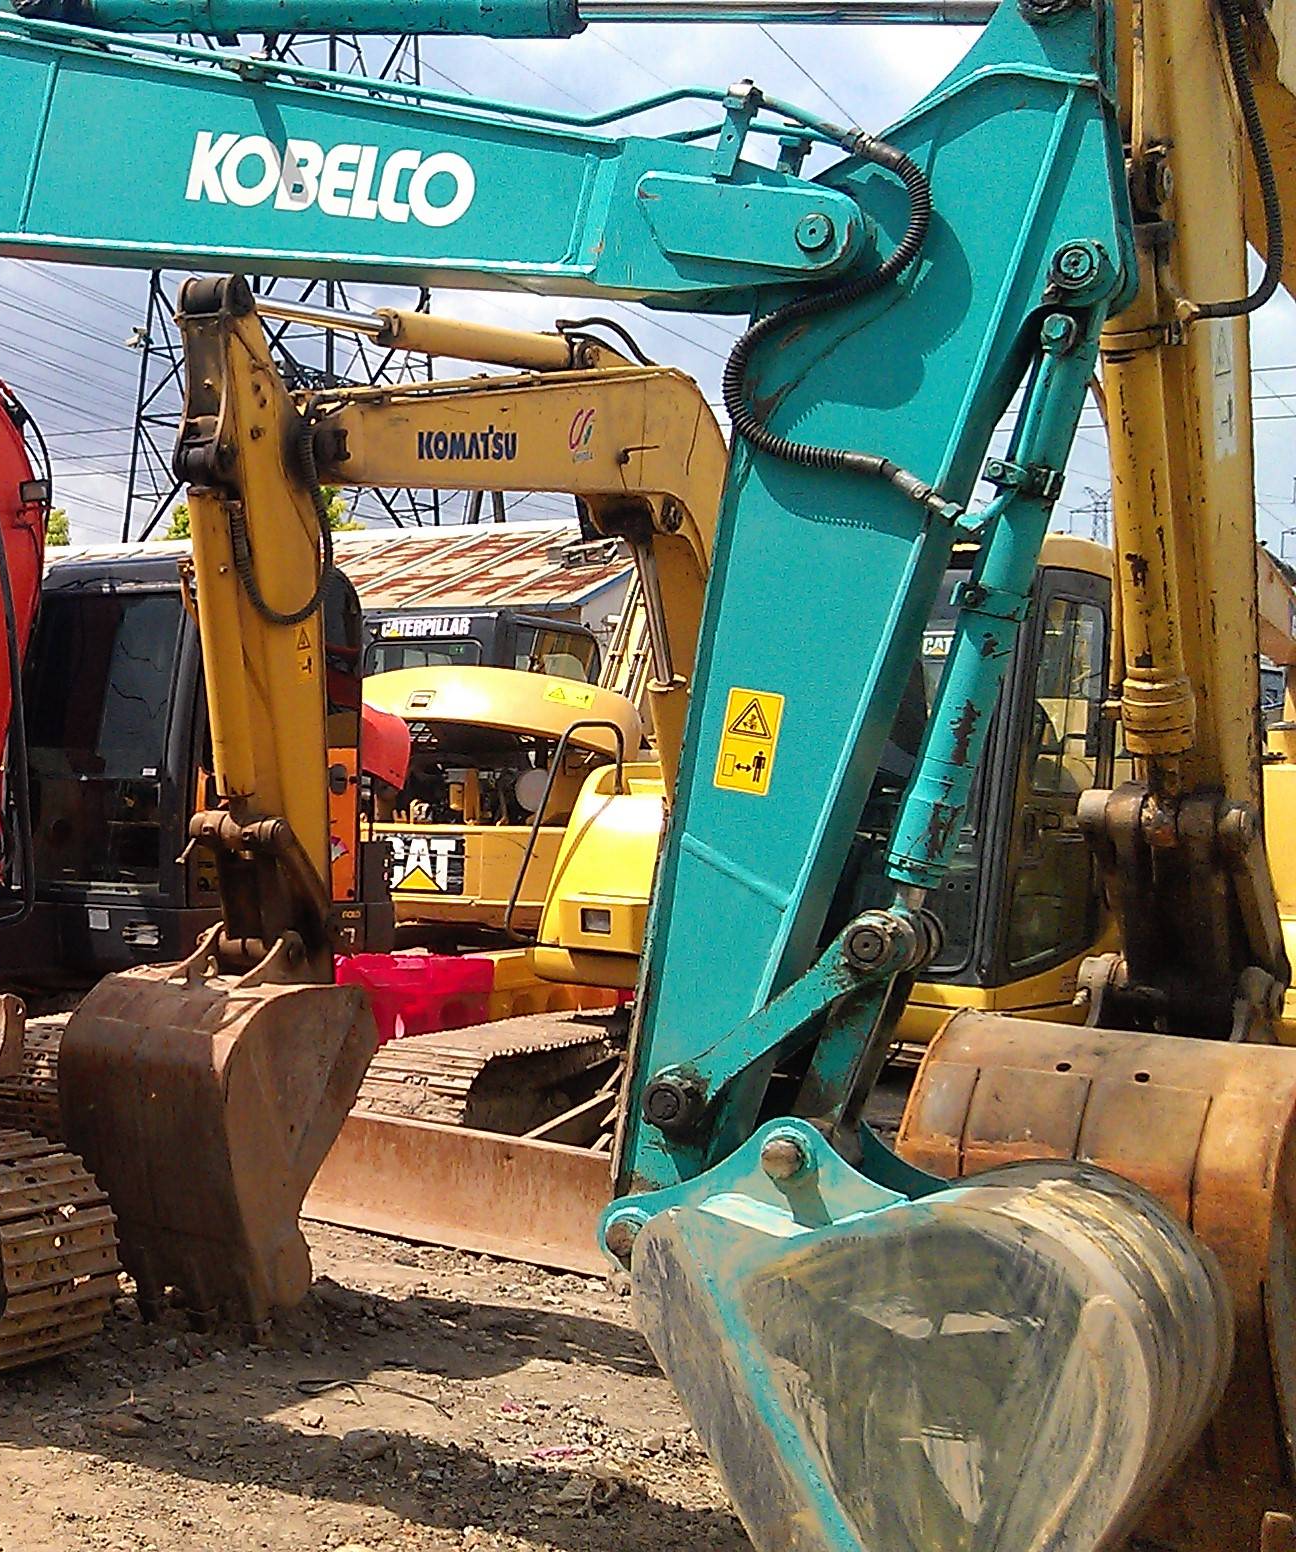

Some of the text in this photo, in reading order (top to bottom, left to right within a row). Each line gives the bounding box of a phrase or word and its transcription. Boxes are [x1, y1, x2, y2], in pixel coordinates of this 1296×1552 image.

[185, 130, 476, 227] KOBELCO
[417, 424, 517, 461] KOMATSU
[381, 617, 471, 638] CATERPILLAR
[922, 637, 954, 656] CAT
